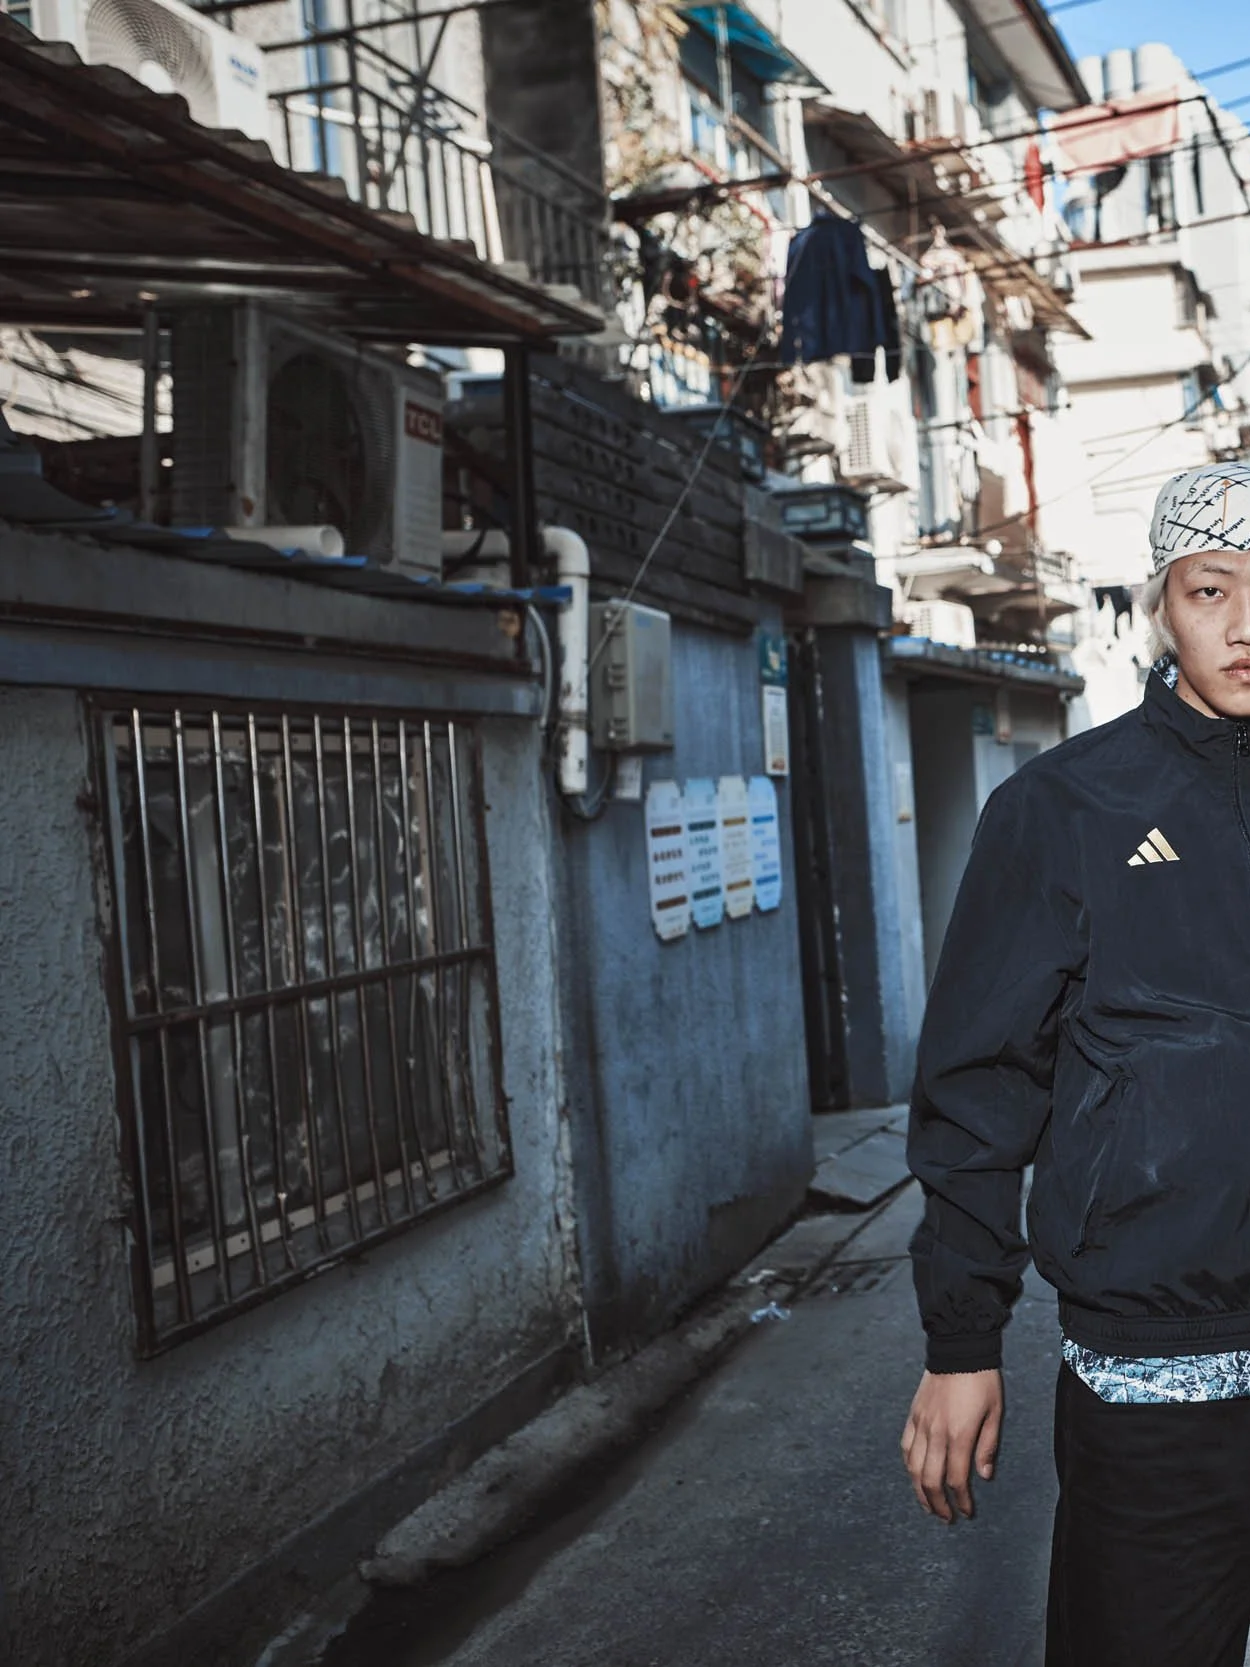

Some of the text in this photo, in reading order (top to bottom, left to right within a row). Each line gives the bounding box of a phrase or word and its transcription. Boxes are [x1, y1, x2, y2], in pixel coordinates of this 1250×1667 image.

[407, 410, 442, 438] TCL
[1209, 517, 1223, 528] July
[1224, 517, 1246, 535] August
